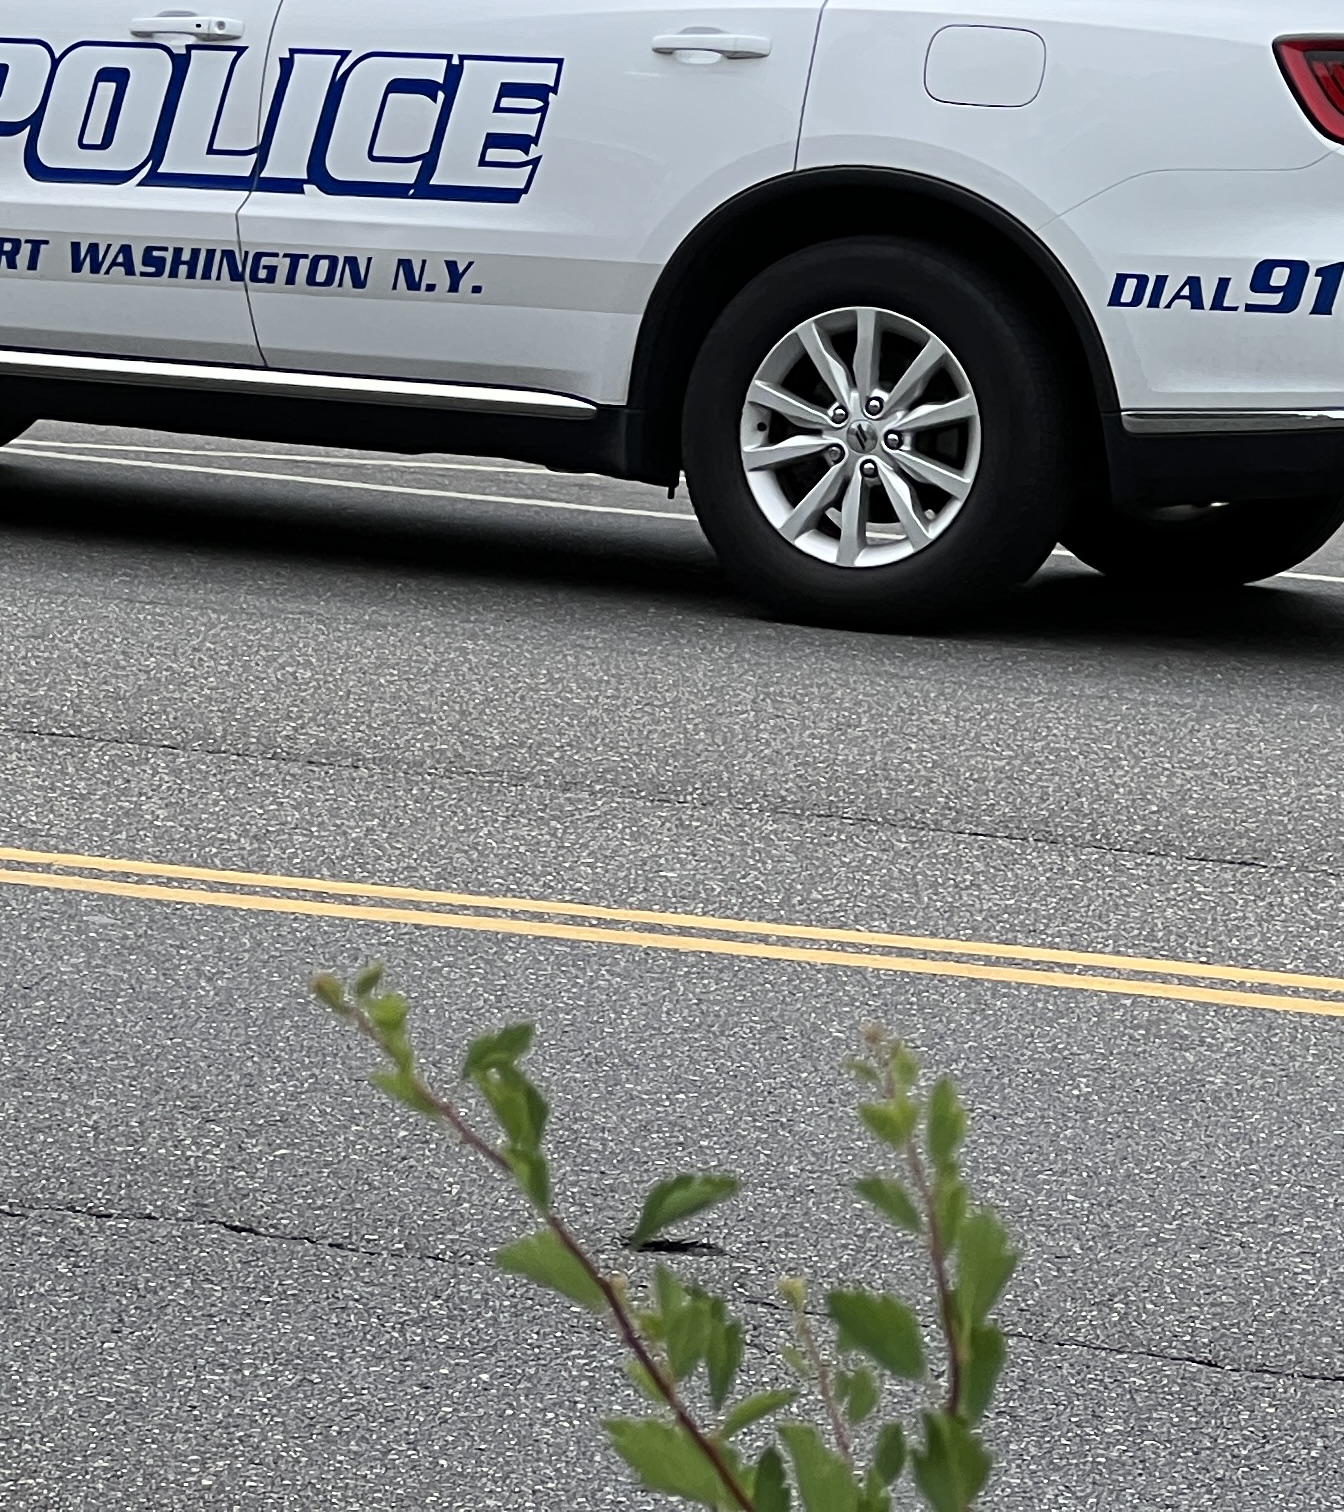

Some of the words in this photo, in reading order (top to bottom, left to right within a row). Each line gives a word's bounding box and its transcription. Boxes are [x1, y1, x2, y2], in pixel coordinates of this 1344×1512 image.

[70, 241, 373, 290] WASHINGTON
[392, 258, 484, 295] N.Y.
[1107, 272, 1239, 312] DIAL
